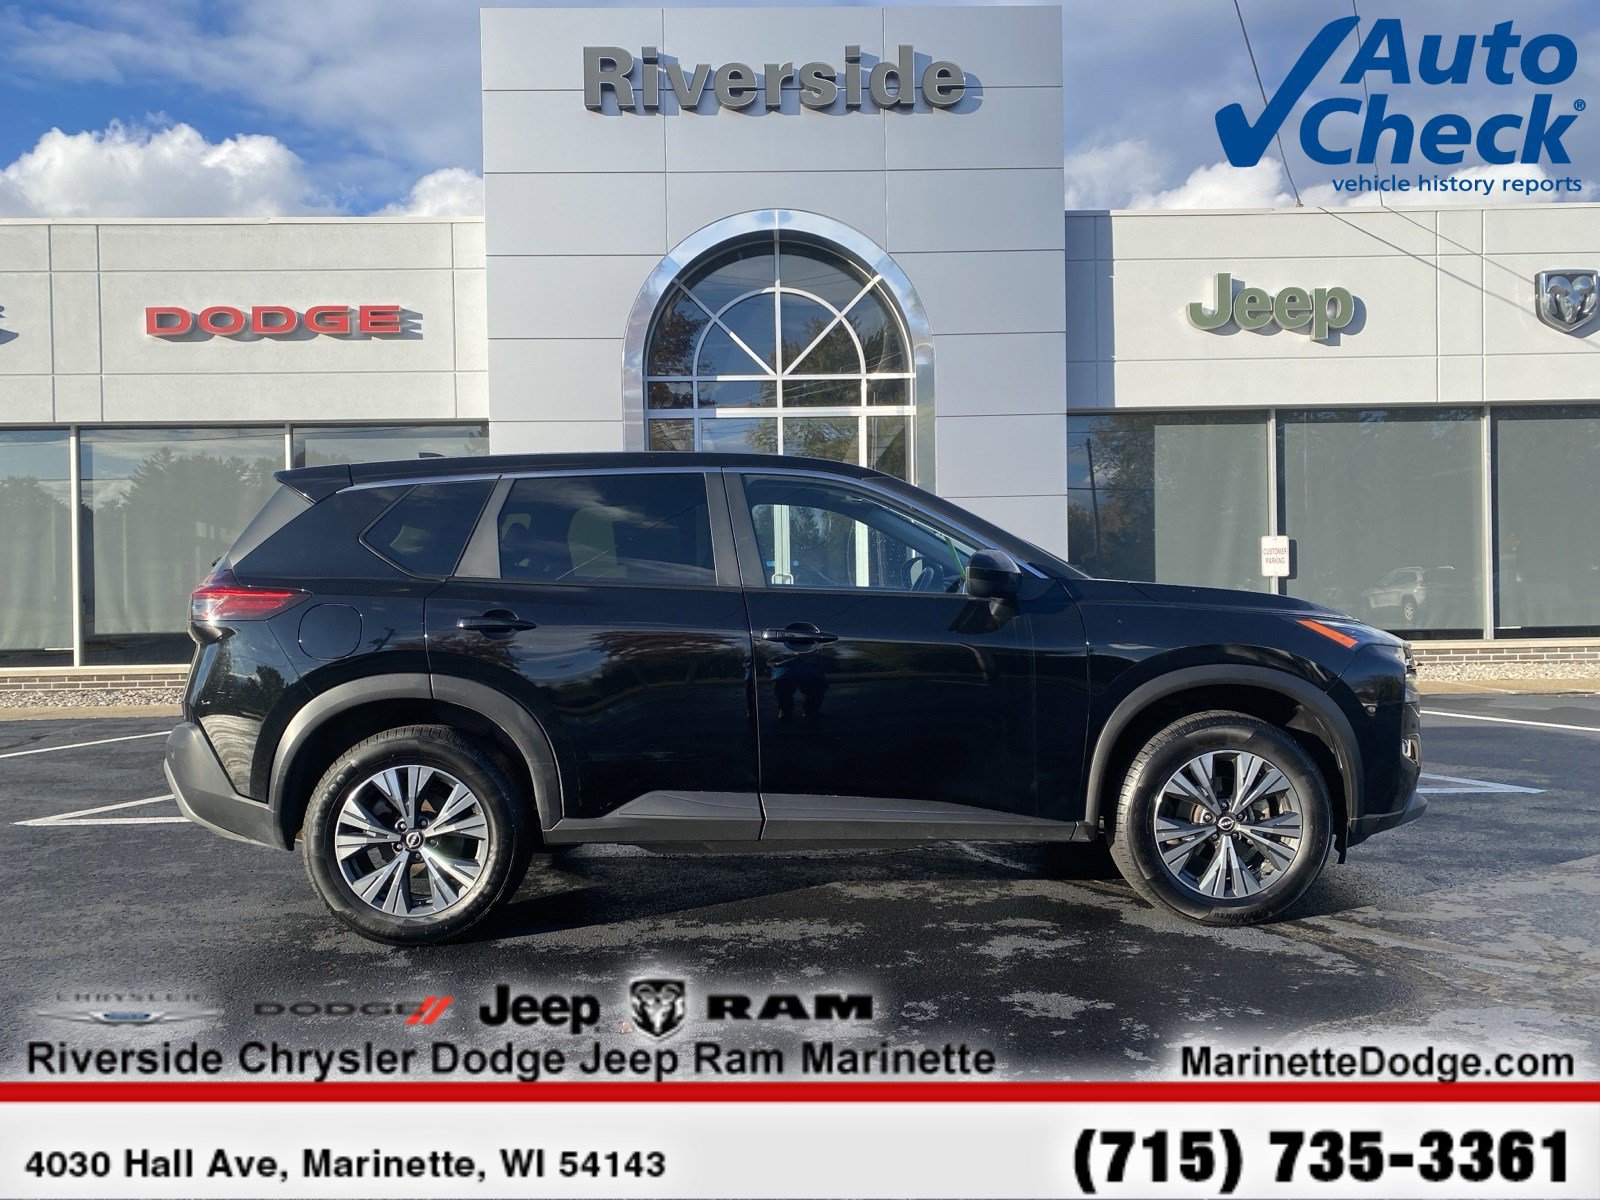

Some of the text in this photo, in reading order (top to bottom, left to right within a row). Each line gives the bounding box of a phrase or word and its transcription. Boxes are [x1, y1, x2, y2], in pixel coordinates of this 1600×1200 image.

[583, 45, 966, 110] Riverside
[145, 305, 402, 335] DODGE
[1187, 272, 1355, 341] Jeep
[1262, 547, 1287, 556] CUSTOMER
[1265, 557, 1286, 565] PARKING
